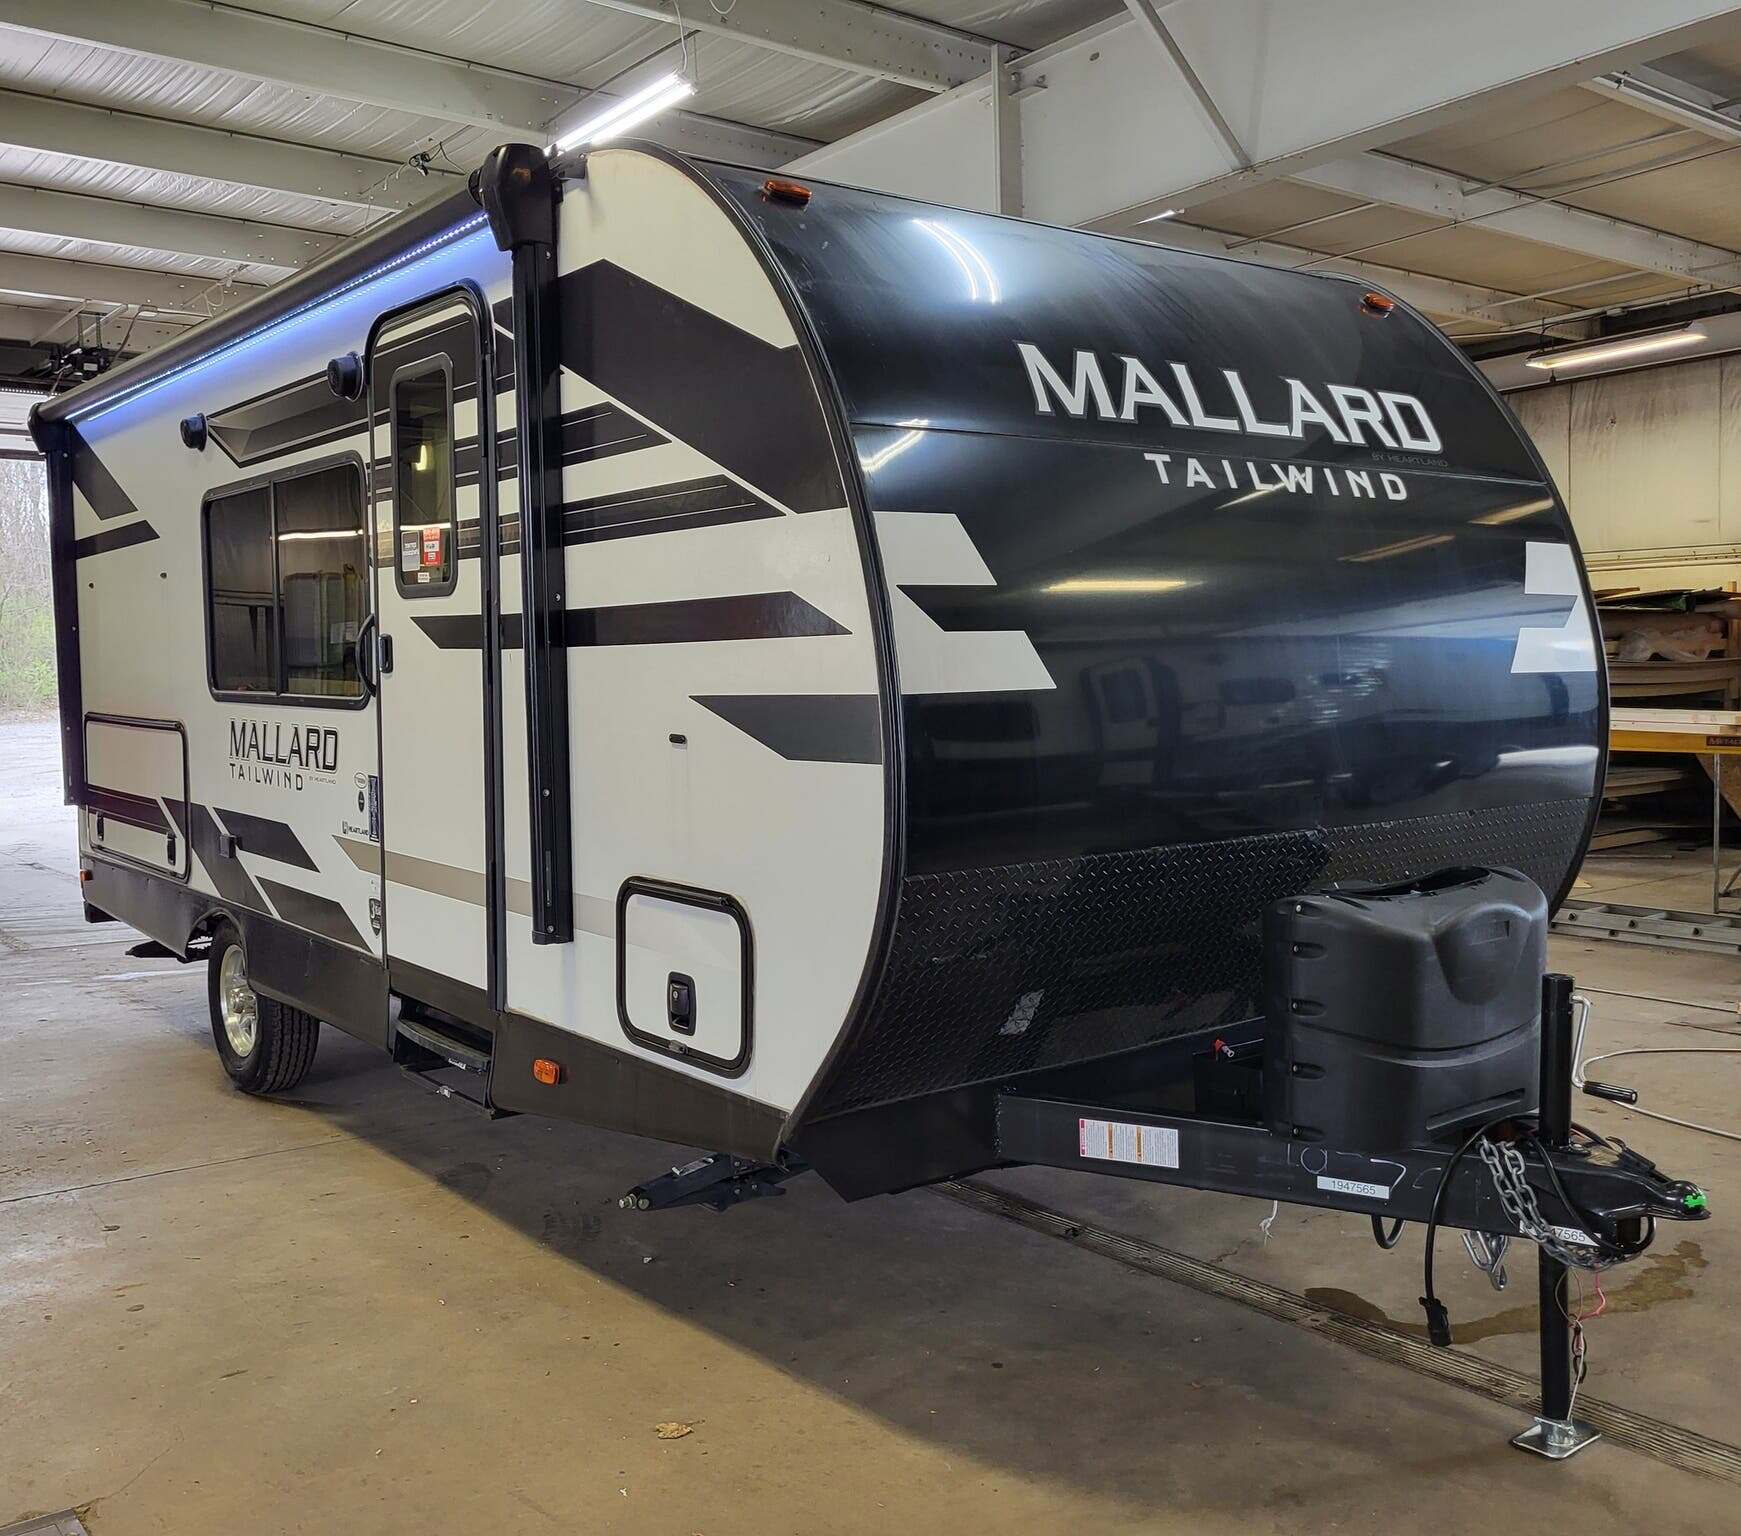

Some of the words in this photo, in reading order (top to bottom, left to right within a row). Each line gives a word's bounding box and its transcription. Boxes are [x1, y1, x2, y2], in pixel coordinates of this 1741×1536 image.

[1015, 342, 1442, 454] MALLARD
[1143, 452, 1408, 501] TAILWIND
[229, 719, 338, 773] MALLARD
[229, 763, 303, 791] TAILWIND
[1331, 1180, 1376, 1196] 1947565
